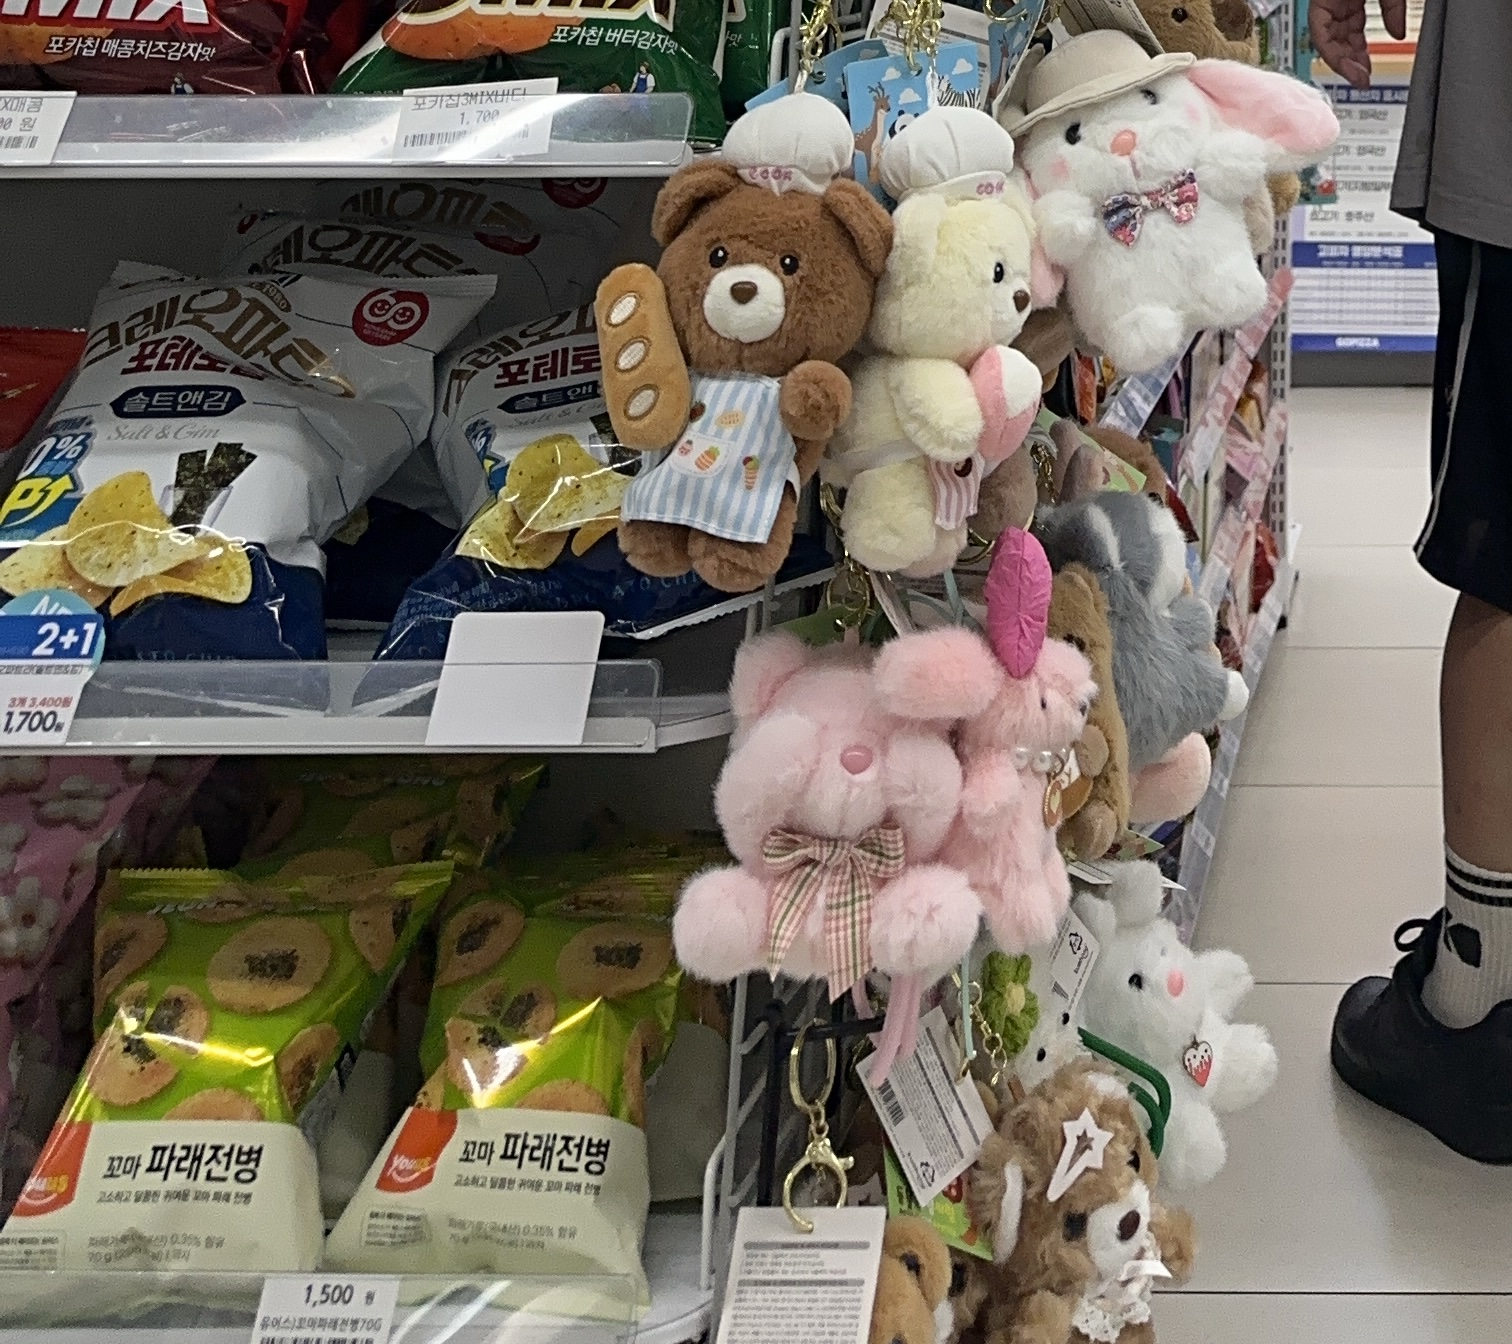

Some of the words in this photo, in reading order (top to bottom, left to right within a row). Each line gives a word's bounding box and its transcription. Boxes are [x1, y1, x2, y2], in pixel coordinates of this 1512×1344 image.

[45, 36, 99, 57] 포카칩
[101, 37, 216, 63] 매콤치즈감자맛
[549, 25, 604, 47] 포카칩
[604, 27, 680, 56] 버터감자맛
[123, 389, 231, 413] 솔트앤김
[31, 621, 97, 657] 2+1
[102, 1154, 143, 1181] 꼬마
[145, 1141, 265, 1185] 파래전병
[458, 1139, 495, 1166] 꼬마
[499, 1131, 612, 1177] 파래전병
[304, 1283, 355, 1308] 1,500
